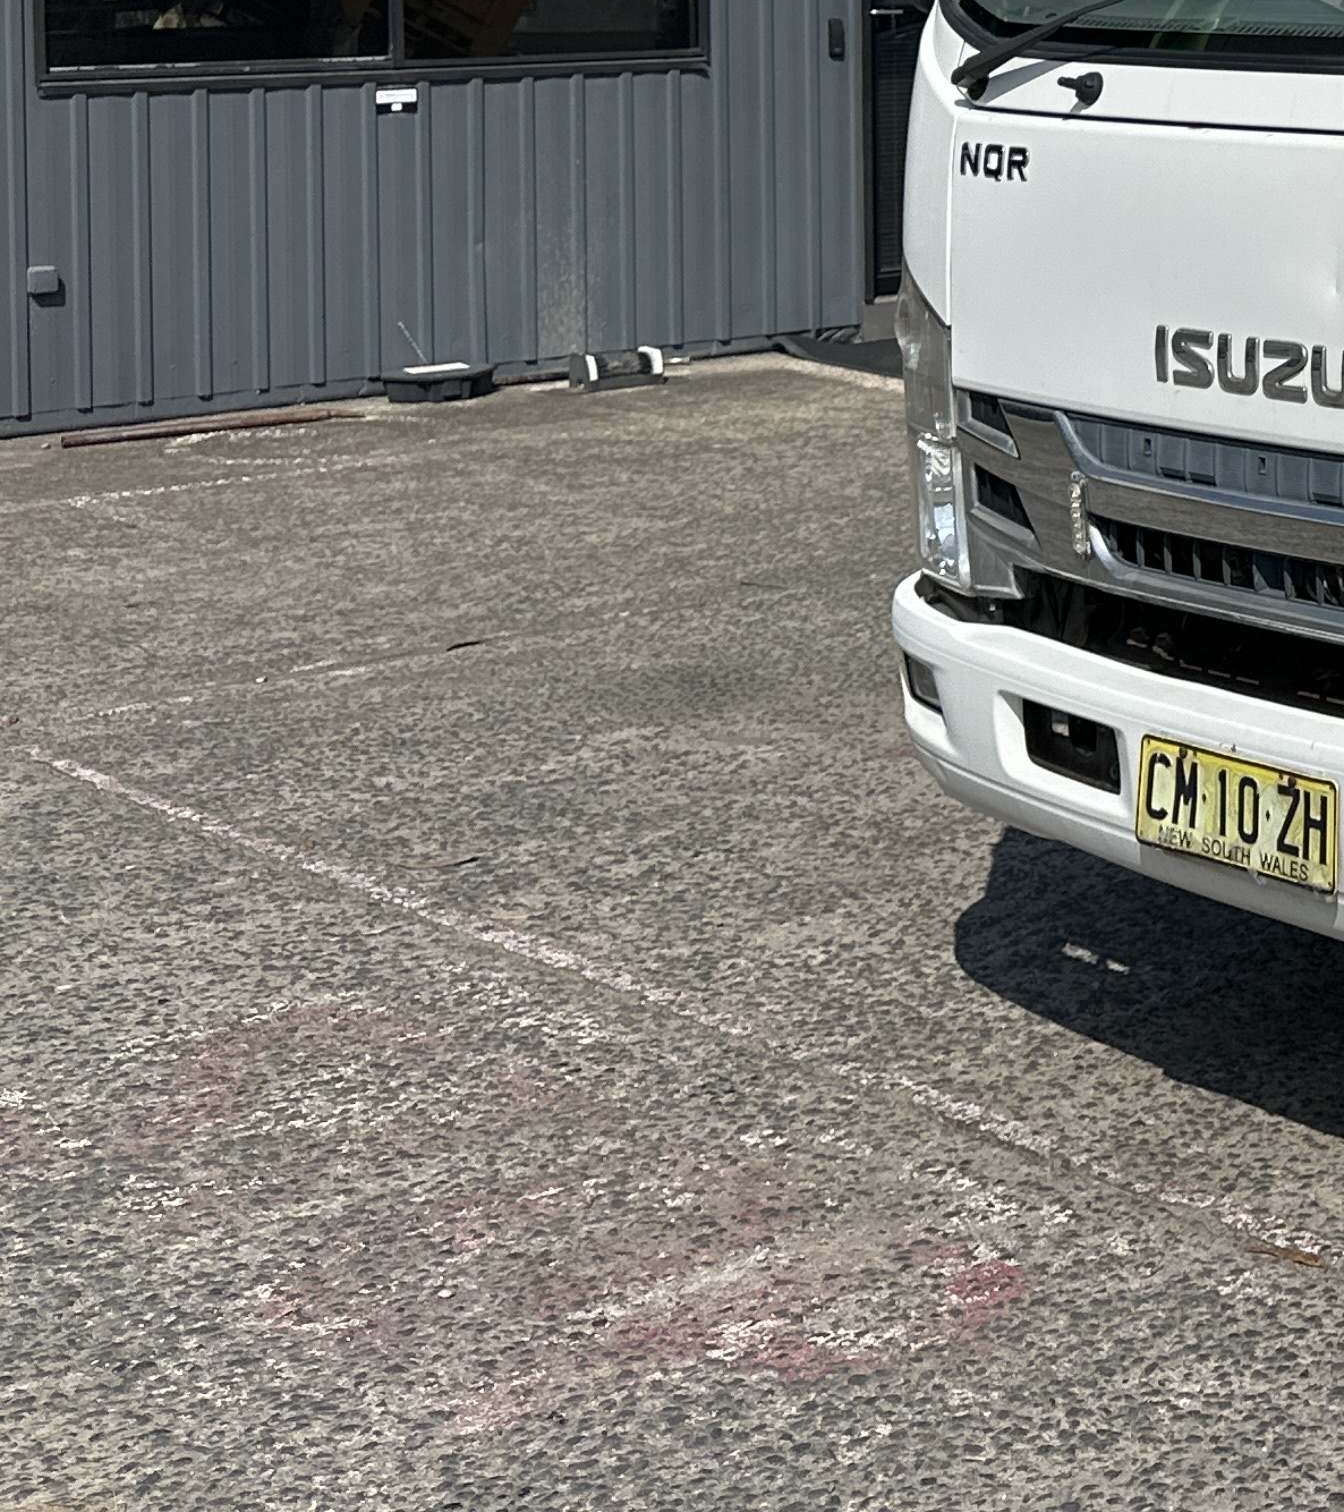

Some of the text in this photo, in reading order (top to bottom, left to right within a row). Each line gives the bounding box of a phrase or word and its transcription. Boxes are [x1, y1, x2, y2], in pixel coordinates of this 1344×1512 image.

[959, 141, 1030, 182] NQR
[1157, 824, 1309, 882] NEW SOUTH WALES
